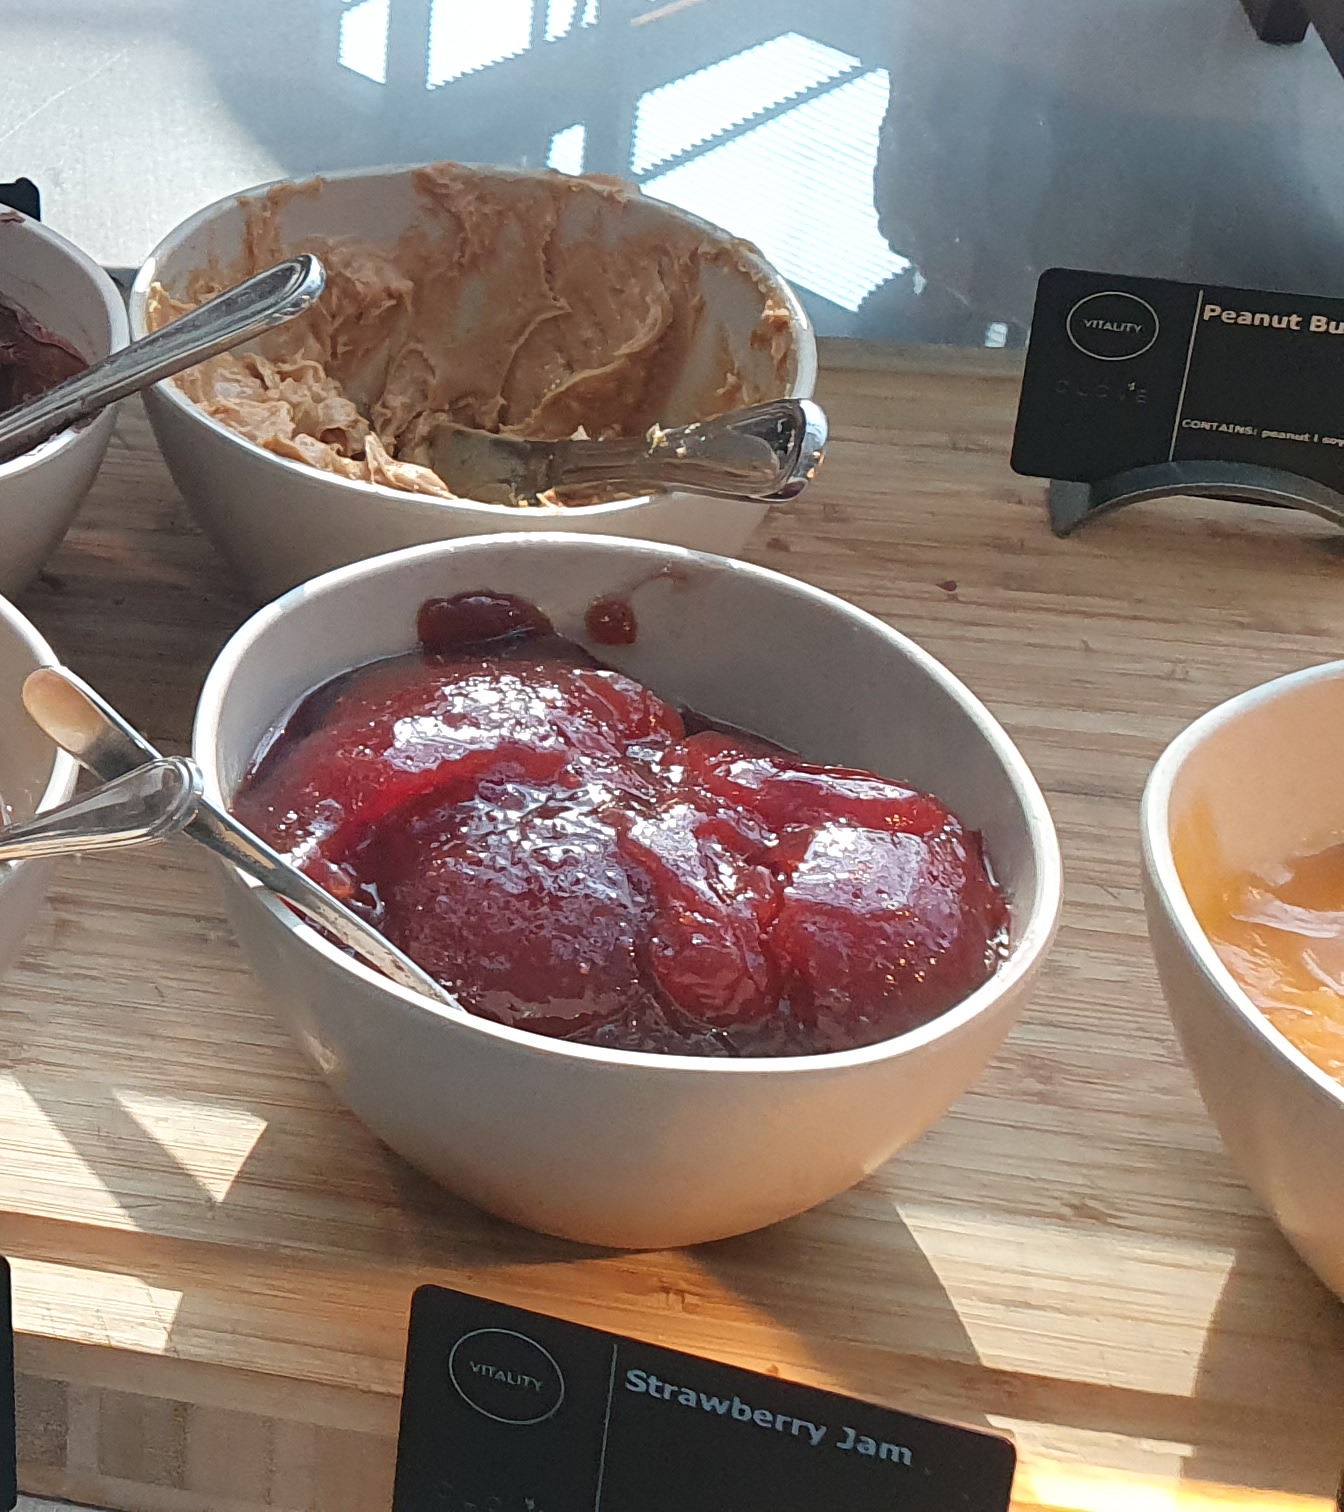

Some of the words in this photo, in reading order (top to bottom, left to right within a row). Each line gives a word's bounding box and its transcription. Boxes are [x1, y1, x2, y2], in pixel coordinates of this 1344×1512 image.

[1082, 318, 1144, 334] VITALITY
[1203, 304, 1303, 332] Peanut
[1309, 315, 1344, 335] Bu
[1181, 418, 1258, 436] CONTAINS:
[1261, 429, 1311, 443] peanut
[468, 1359, 546, 1394] VITALITY
[625, 1367, 828, 1447] Strawberry
[836, 1425, 914, 1468] Jam
